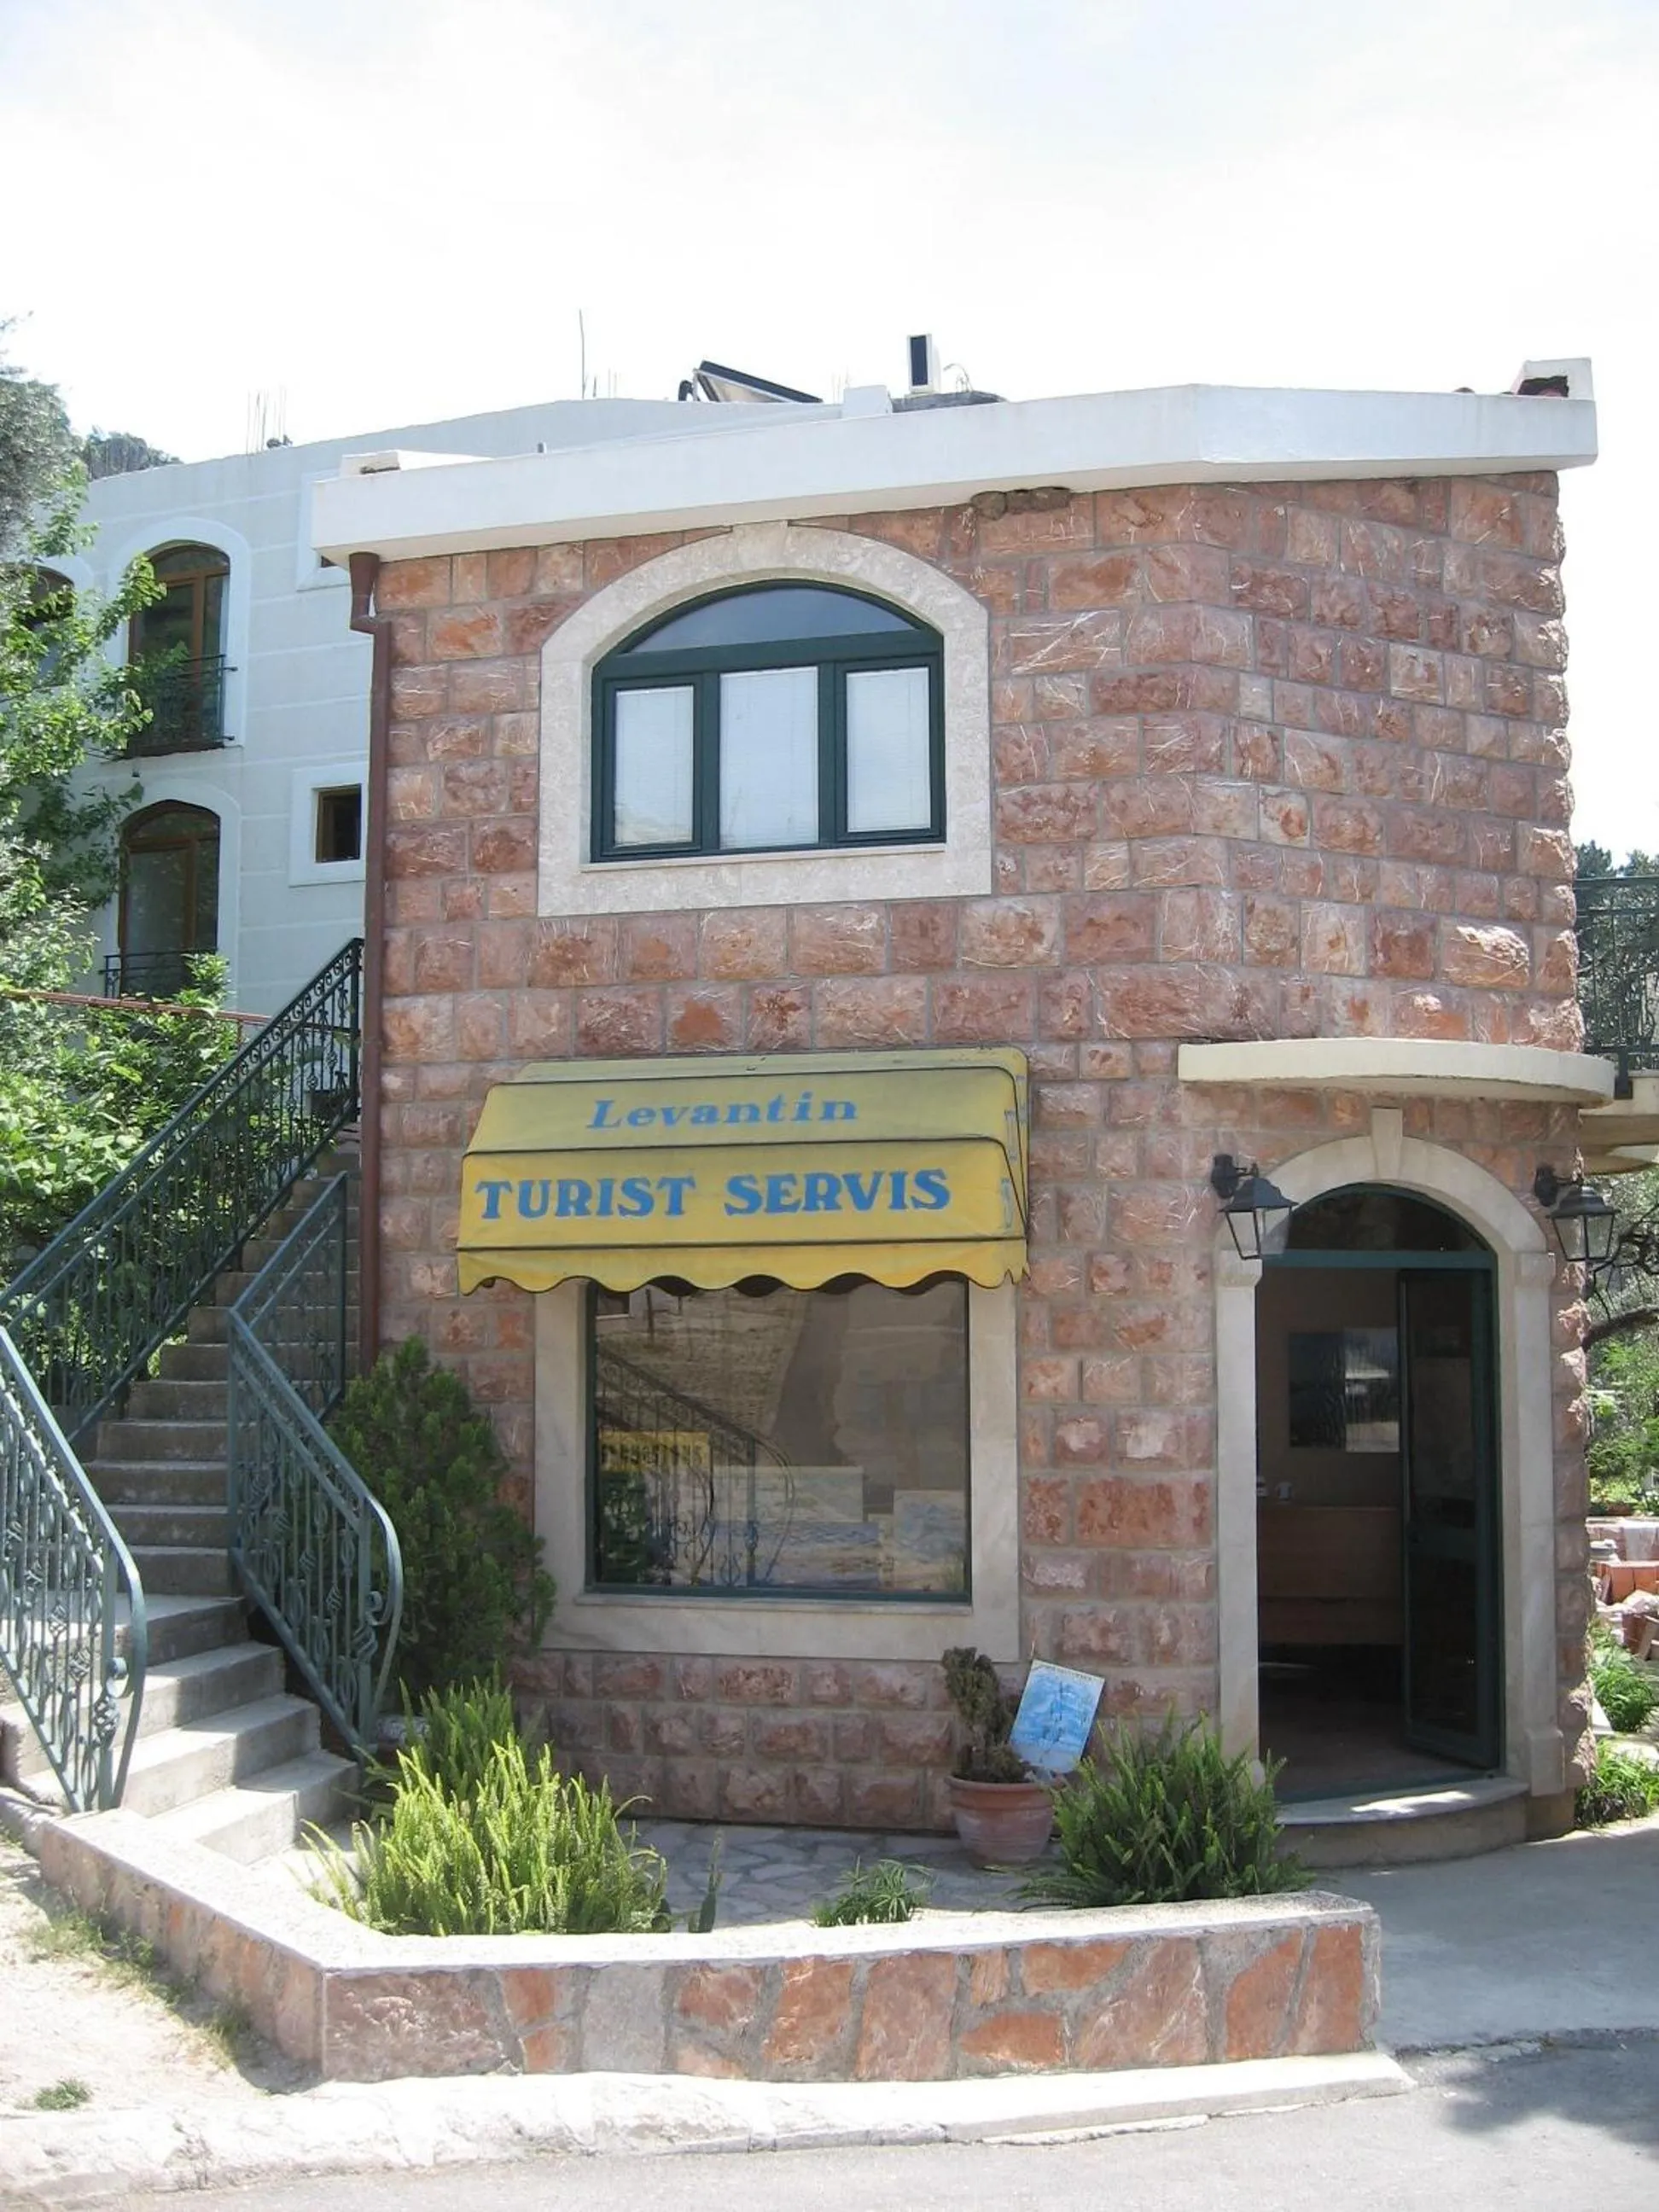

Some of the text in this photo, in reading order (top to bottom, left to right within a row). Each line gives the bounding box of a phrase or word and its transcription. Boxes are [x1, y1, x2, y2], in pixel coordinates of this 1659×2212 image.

[586, 1091, 859, 1129] Levantin
[474, 1167, 952, 1220] TURIST SERVIS
